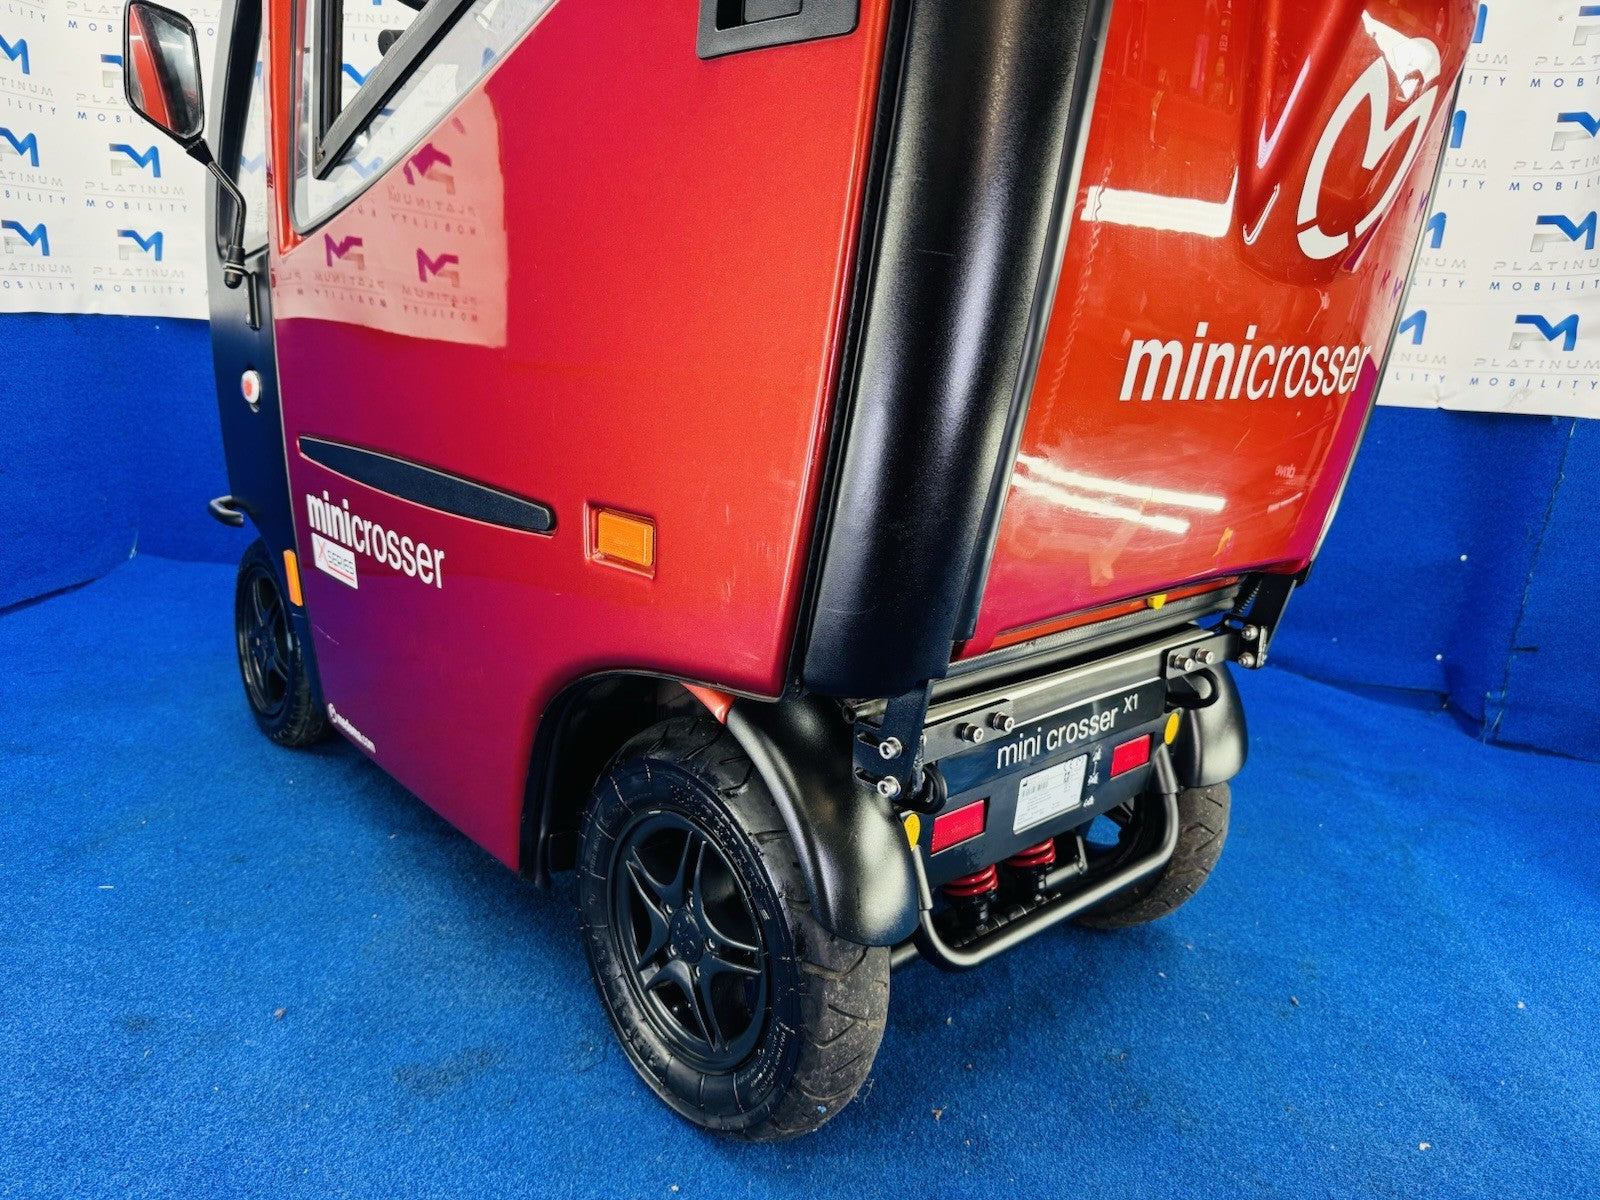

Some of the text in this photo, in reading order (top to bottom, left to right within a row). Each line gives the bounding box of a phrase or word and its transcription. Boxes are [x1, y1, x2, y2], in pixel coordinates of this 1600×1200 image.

[9, 3, 46, 22] LITY
[66, 1, 121, 14] PLAT
[1534, 55, 1600, 66] PLAT
[0, 76, 54, 97] TINUM
[1529, 75, 1600, 88] MOBI
[8, 98, 56, 115] ILITY
[1513, 155, 1600, 170] PLATIN
[0, 170, 63, 187] ATINUM
[1508, 176, 1600, 191] MOBILI
[84, 181, 185, 195] PLATINUM
[5, 190, 66, 204] BILITY
[86, 199, 188, 213] MOBILITY
[1493, 258, 1600, 271] PLATINU
[93, 266, 185, 279] PLATINUM
[3, 280, 76, 291] OBILITY
[94, 283, 185, 295] MOBILITY
[1489, 279, 1600, 291] MOBILIT
[1119, 321, 1373, 401] minicrosser
[1473, 358, 1600, 369] PLATINUM
[1396, 372, 1446, 383] LITY
[1468, 377, 1598, 390] MOBILITY
[306, 490, 445, 589] minicrosser
[997, 693, 1139, 770] mini crosser X1
